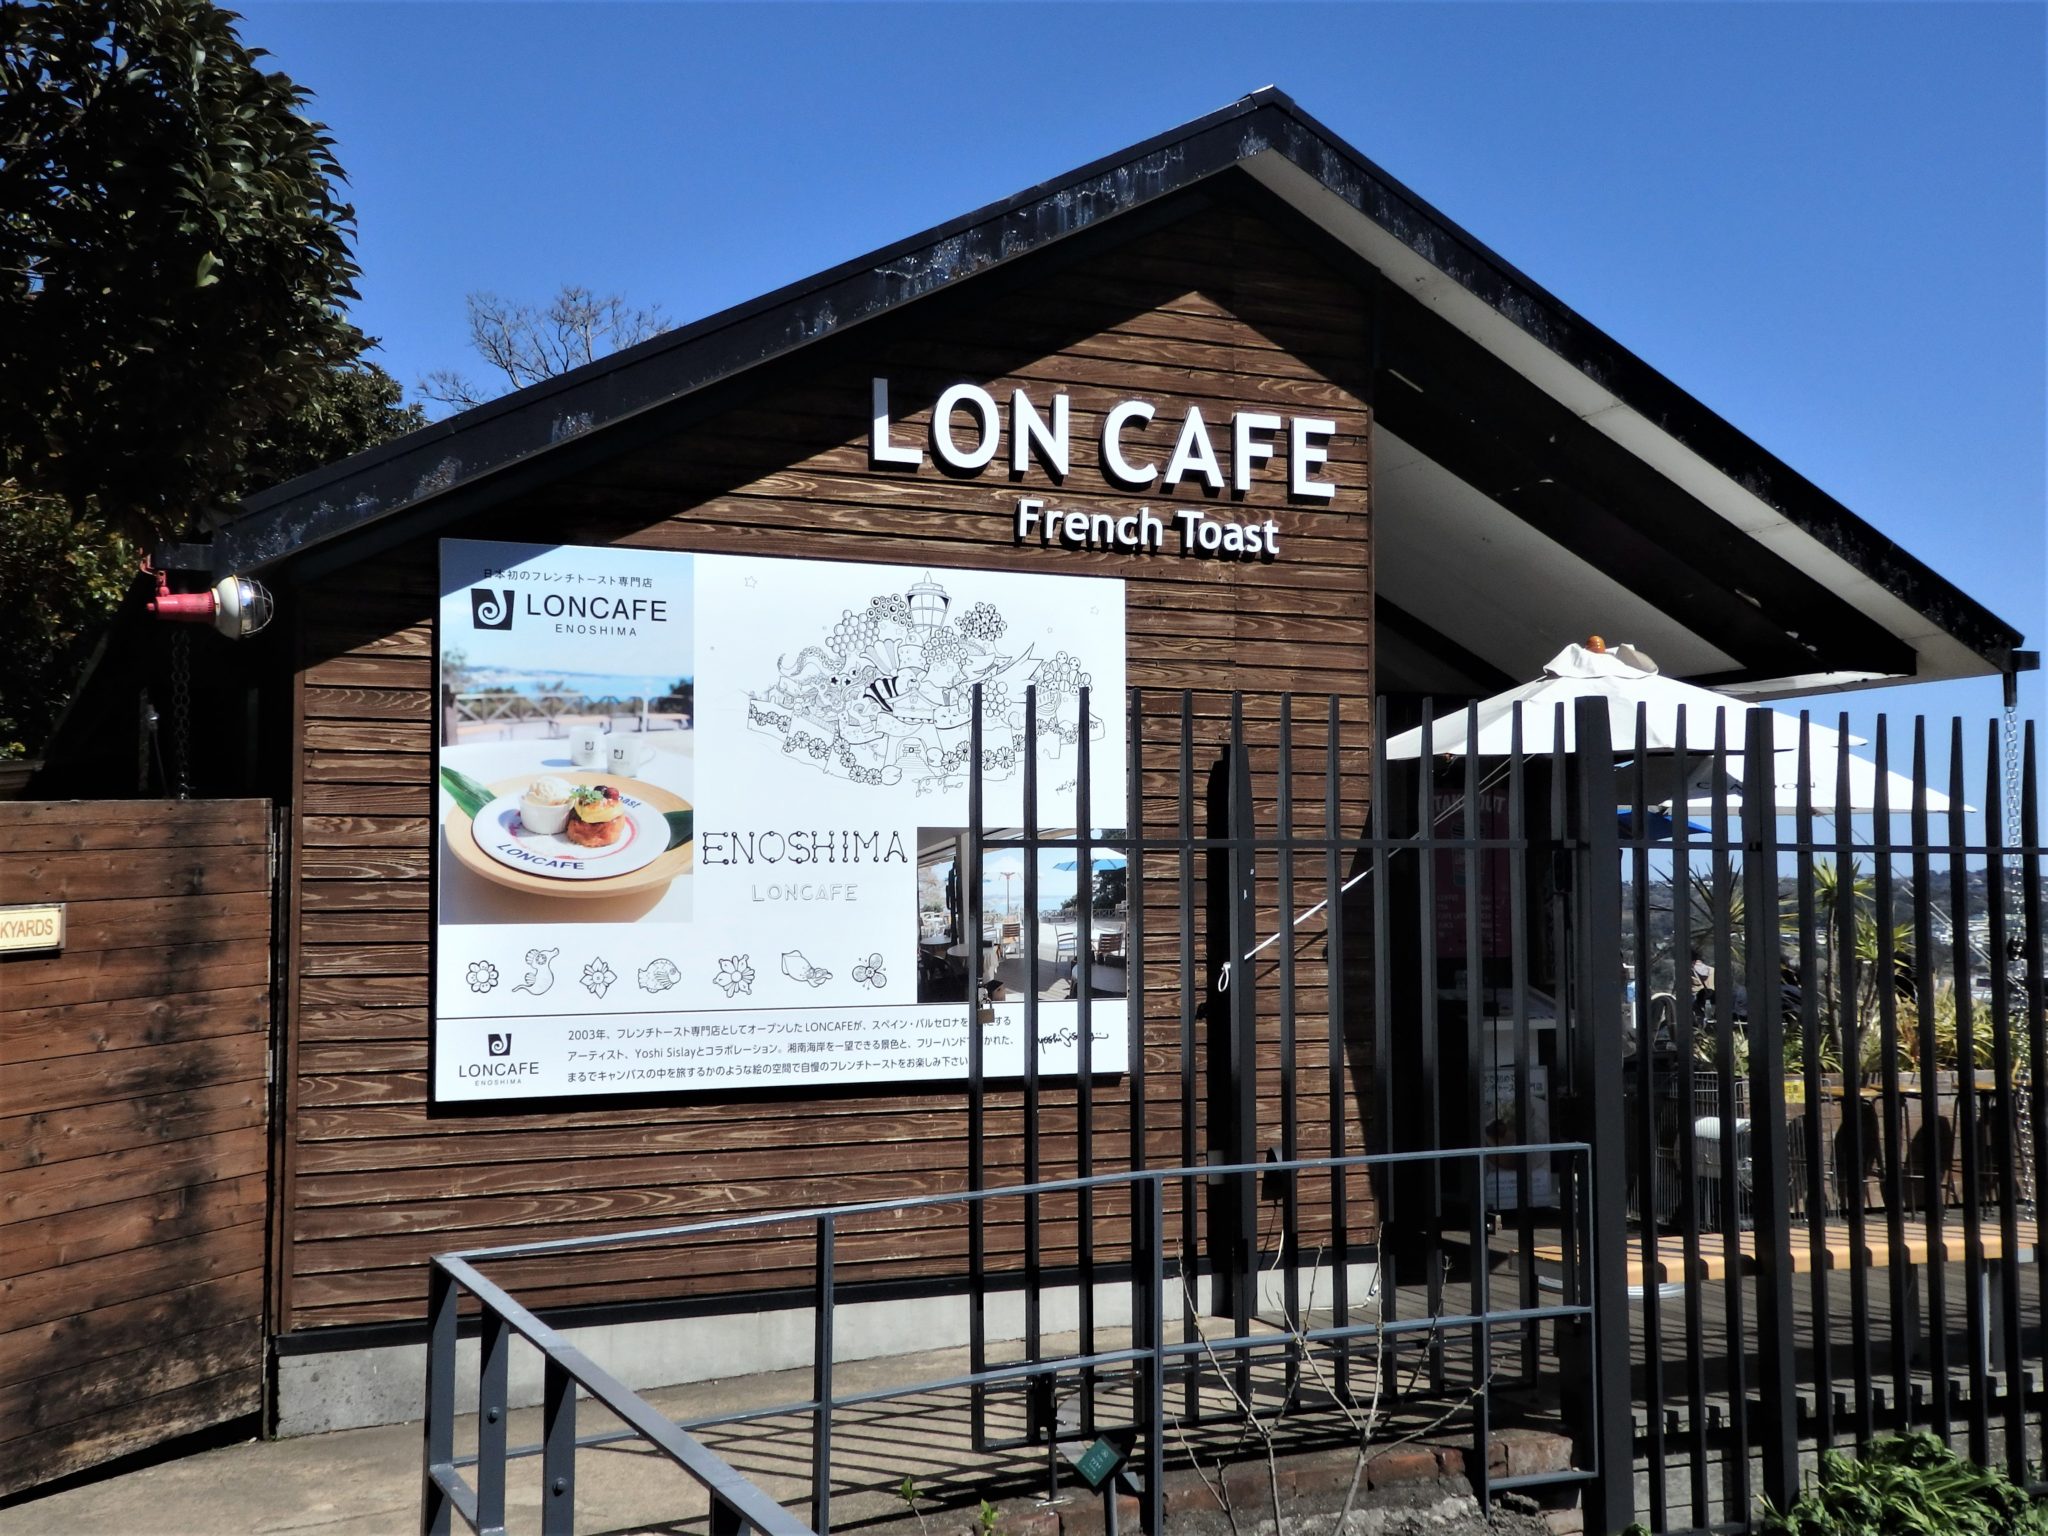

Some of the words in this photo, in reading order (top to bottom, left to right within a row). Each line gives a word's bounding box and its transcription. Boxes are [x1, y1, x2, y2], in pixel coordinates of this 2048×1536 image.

[871, 377, 1070, 477] LON
[1102, 400, 1336, 498] CAFE
[1016, 498, 1164, 547] French
[1177, 509, 1281, 555] Toast
[483, 568, 653, 589] 日本初のフレンチトースト専門店
[526, 593, 668, 622] LONCAFE
[555, 623, 638, 637] ENOSHIMA
[497, 843, 585, 871] LONCAFE
[702, 830, 908, 865] ENOSHIMA
[751, 883, 858, 902] LONCAFE
[458, 1061, 540, 1078] LONCAFE
[474, 1078, 522, 1087] ENOSHIMA
